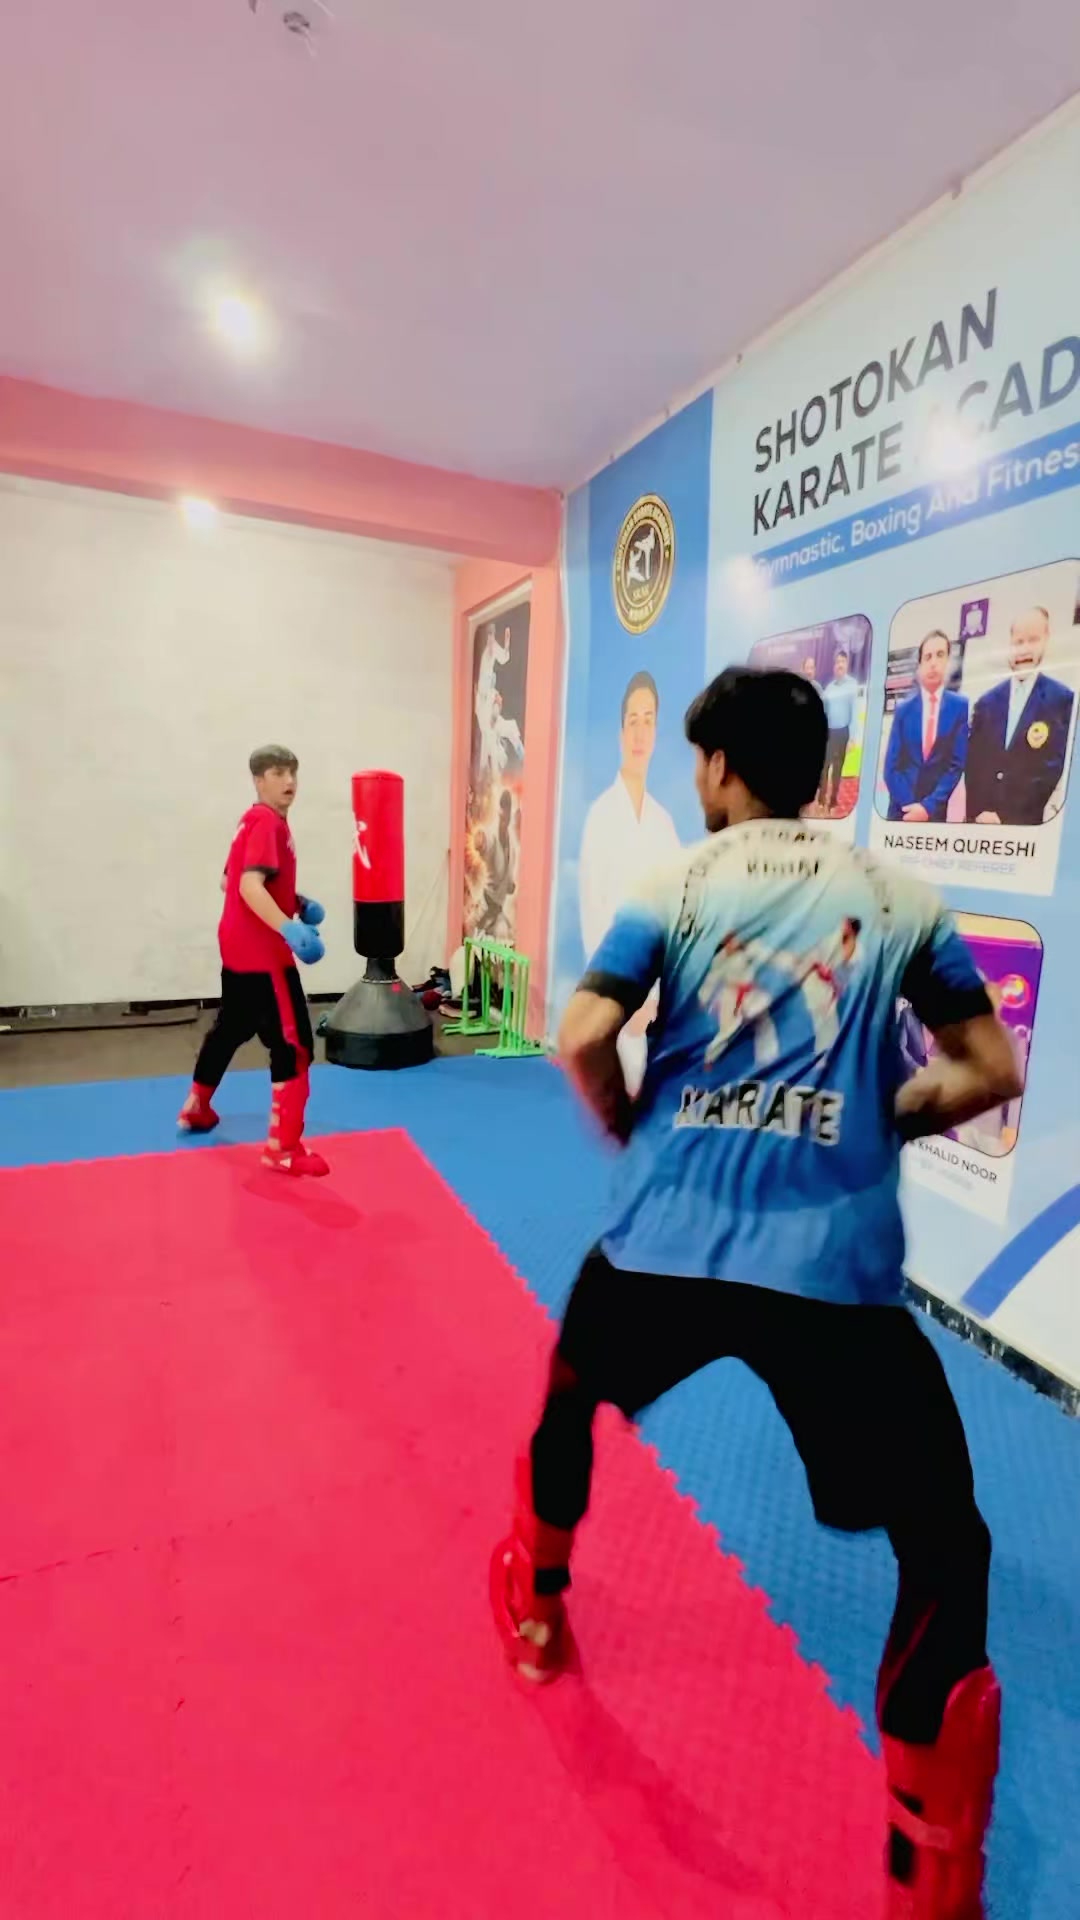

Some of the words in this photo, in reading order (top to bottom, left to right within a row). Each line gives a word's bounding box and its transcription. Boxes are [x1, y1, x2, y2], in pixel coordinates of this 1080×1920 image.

[754, 287, 997, 473] SHOTOKAN
[753, 421, 903, 536] KARATE
[925, 336, 1080, 460] CAD
[852, 504, 921, 547] Boxing
[884, 835, 948, 853] NASEEM
[953, 838, 1036, 858] QURESHI
[919, 1140, 959, 1165] KHALID
[962, 1159, 998, 1184] NOOR
